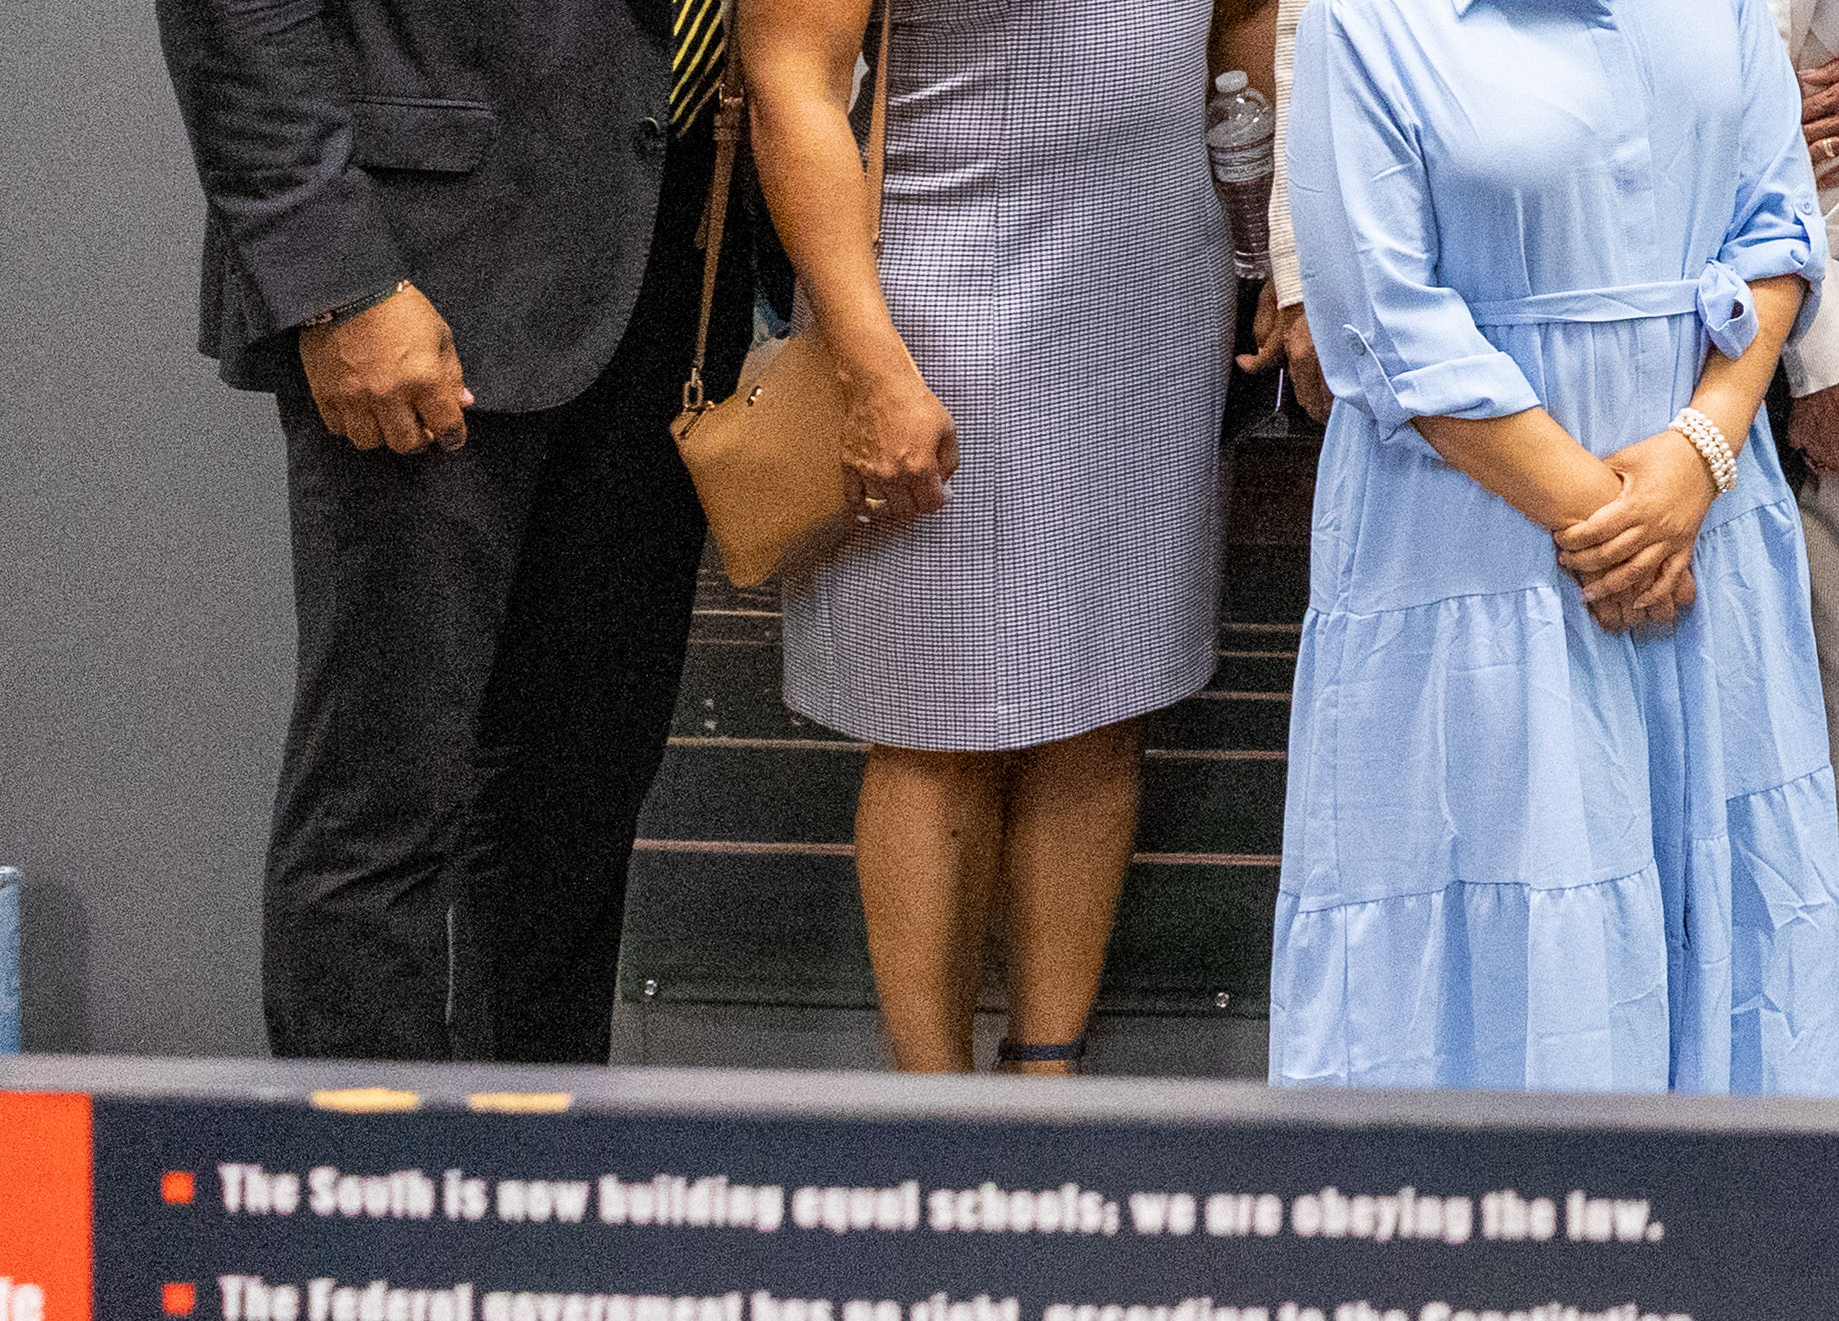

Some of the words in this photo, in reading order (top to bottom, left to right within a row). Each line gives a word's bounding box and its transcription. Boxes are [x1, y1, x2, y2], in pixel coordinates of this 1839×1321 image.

[219, 1164, 299, 1215] The
[309, 1166, 435, 1219] South
[444, 1169, 487, 1219] is
[498, 1180, 589, 1222] now
[600, 1175, 783, 1231] building
[793, 1180, 918, 1235] equal
[1129, 1193, 1196, 1236] we
[1205, 1193, 1281, 1236] are
[1293, 1186, 1471, 1244] obeying
[1481, 1189, 1556, 1239] the
[1566, 1190, 1664, 1240] law.
[219, 1275, 299, 1321] The
[308, 1278, 472, 1321] Federal
